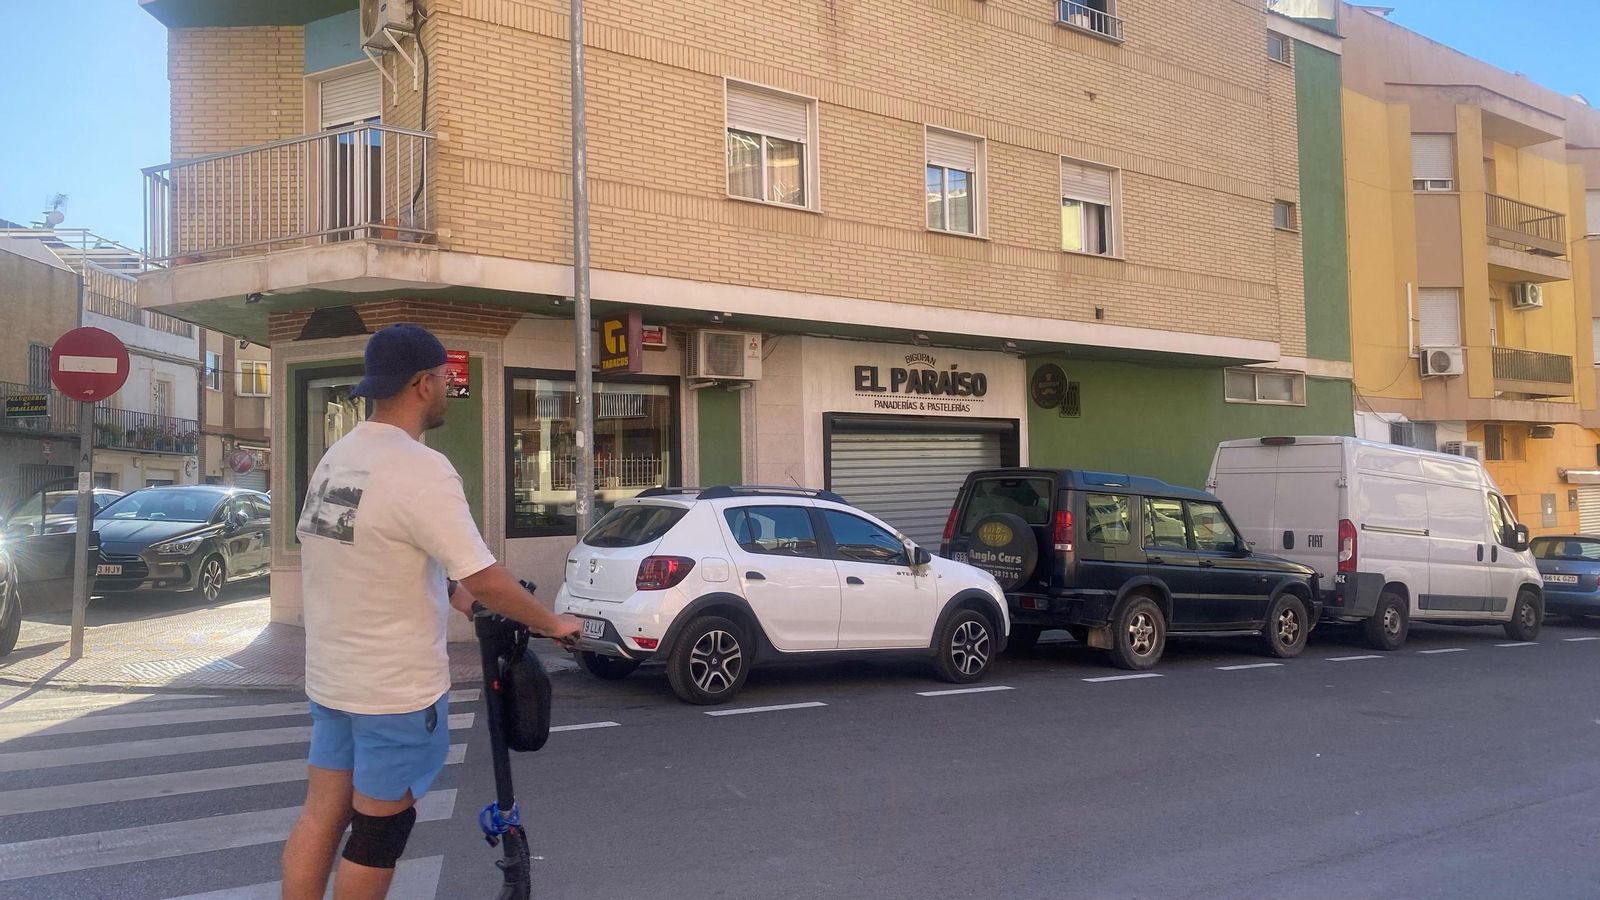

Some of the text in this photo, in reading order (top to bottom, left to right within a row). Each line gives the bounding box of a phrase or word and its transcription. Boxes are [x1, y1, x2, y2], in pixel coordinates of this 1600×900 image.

[602, 357, 629, 369] TABACOS
[904, 353, 936, 366] BIGOPAN
[854, 364, 987, 397] EL PARAÍSO
[874, 400, 971, 413] PANADERÍAS & PASTELERÍAS
[1308, 534, 1324, 548] FIAT
[969, 548, 1022, 564] Anglo Cars
